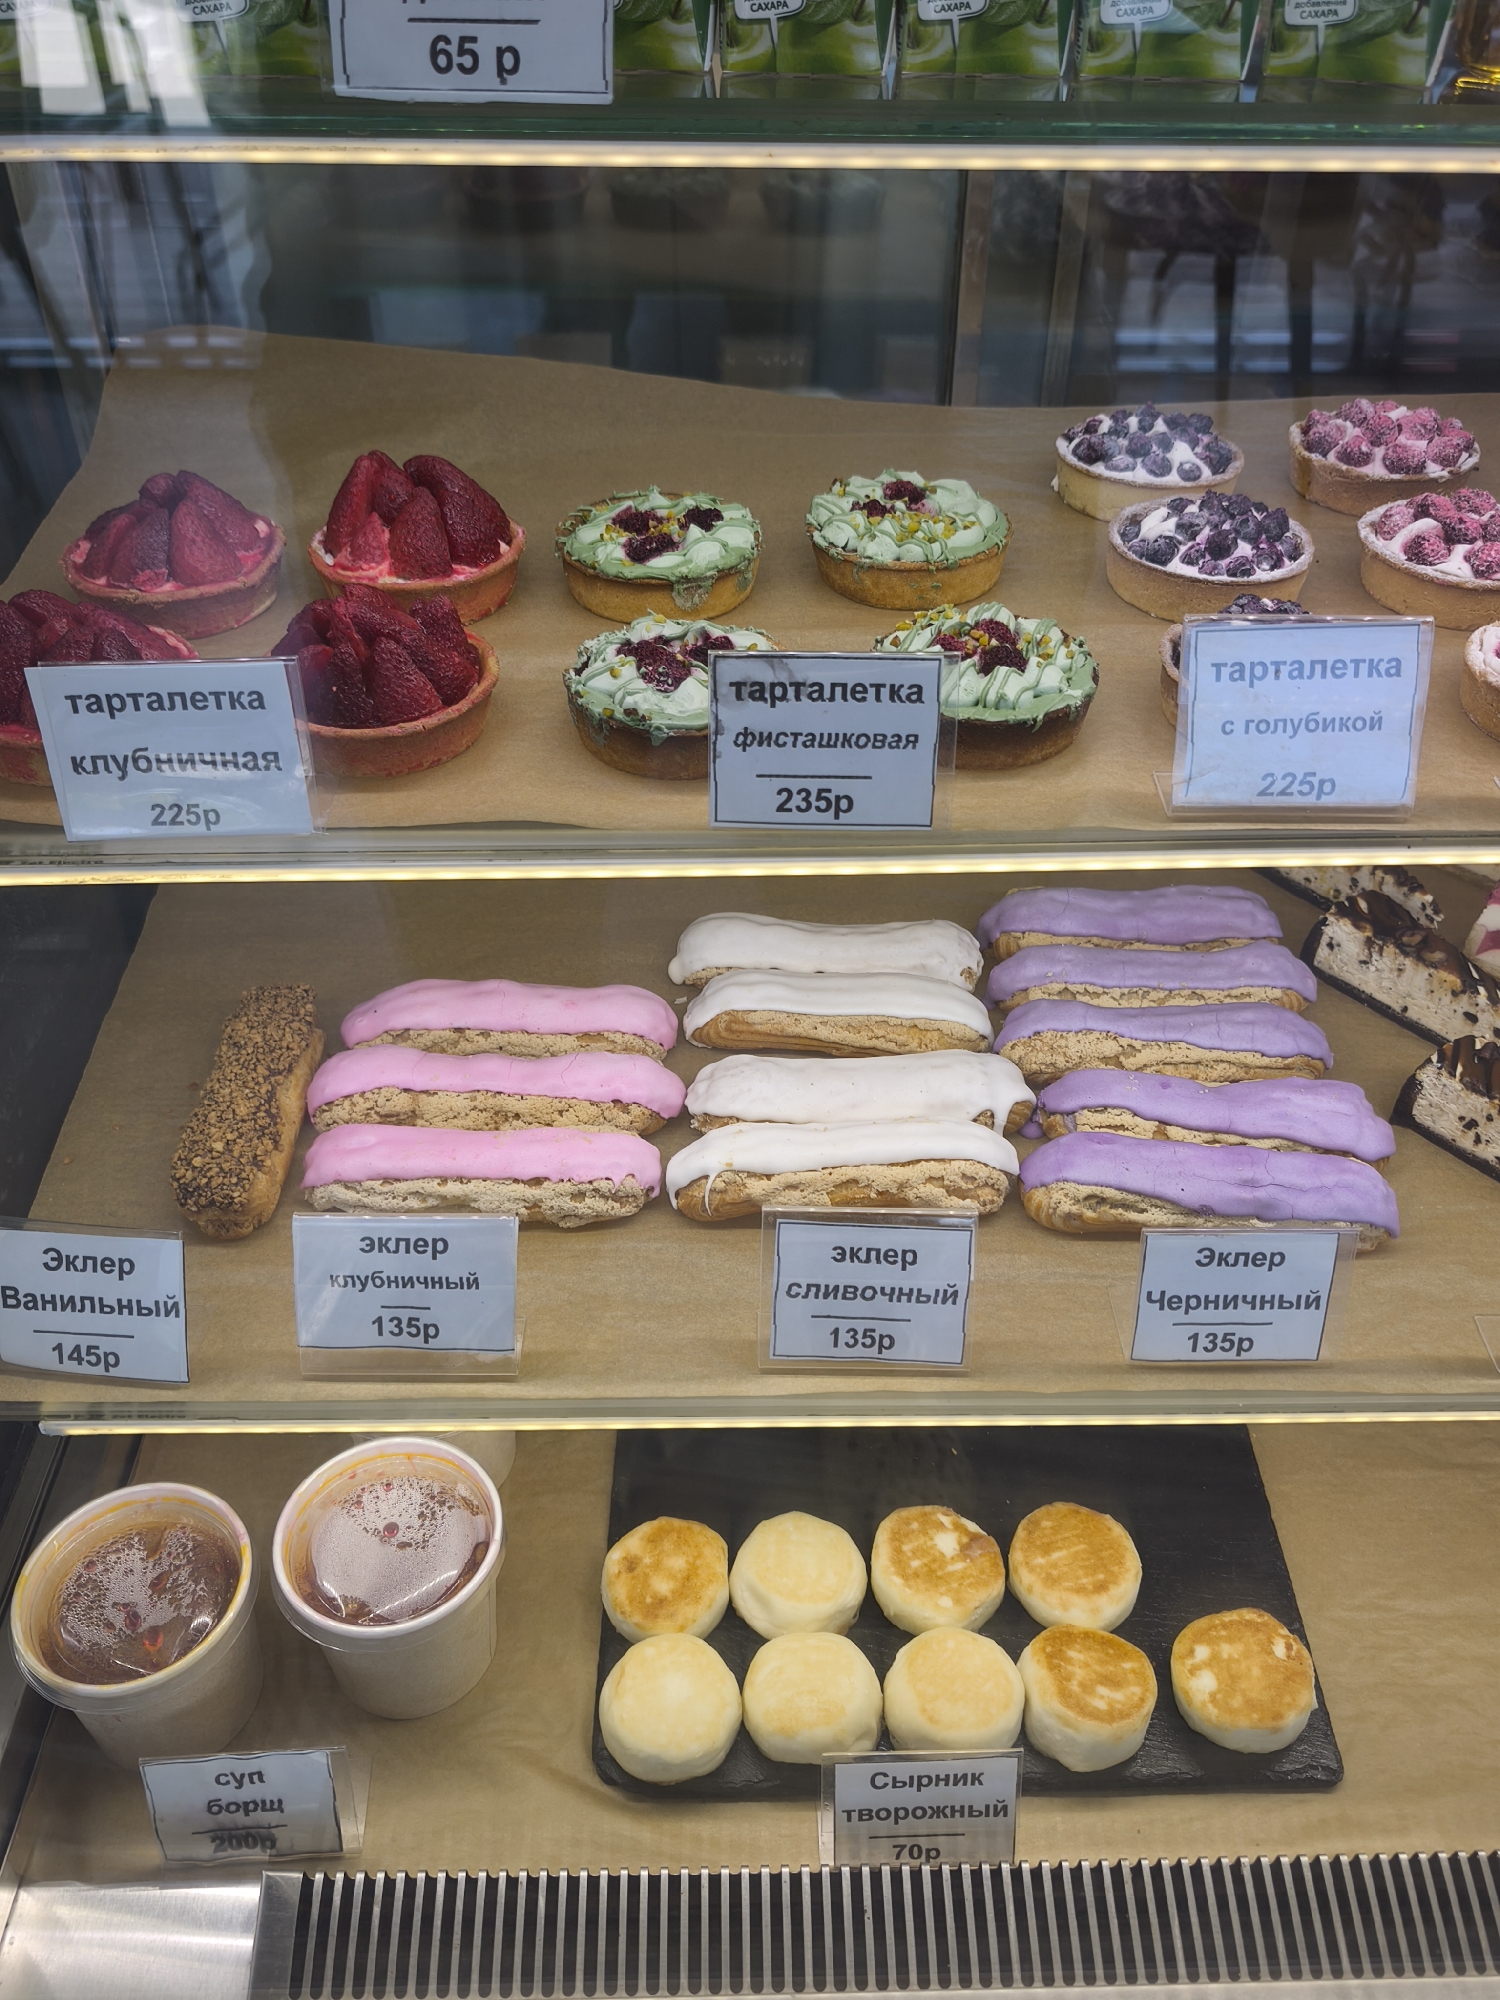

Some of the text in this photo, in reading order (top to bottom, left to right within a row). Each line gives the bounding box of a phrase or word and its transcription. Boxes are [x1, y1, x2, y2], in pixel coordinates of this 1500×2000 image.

[192, 2, 233, 15] САХАРА
[750, 1, 789, 12] САХАРА
[933, 2, 971, 13] САХАРА
[1116, 6, 1154, 17] САХАРА
[1300, 9, 1339, 20] САХАРА
[430, 35, 521, 86] 65 р
[1211, 657, 1402, 688] тарталетка
[65, 690, 266, 719] тарталетка
[729, 681, 925, 708] тарталетка
[1221, 711, 1383, 739] с голубикой
[732, 727, 919, 752] фисташковая
[70, 747, 282, 781] клубничная
[1257, 772, 1336, 801] 225р
[775, 788, 854, 820] 235р
[151, 803, 221, 831] 225р
[359, 1236, 449, 1260] эклер
[831, 1246, 918, 1271] эклер
[1195, 1247, 1286, 1271] Эклер
[42, 1248, 135, 1281] Эклер
[330, 1271, 479, 1292] клубничный
[786, 1282, 959, 1305] сливочный
[0, 1285, 180, 1318] Ванильный
[1146, 1290, 1321, 1315] Черничный
[371, 1316, 440, 1344] 135р
[829, 1327, 895, 1354] 135р
[1187, 1332, 1254, 1357] 135р
[51, 1343, 120, 1373] 145р
[214, 1771, 266, 1790] суп
[870, 1771, 984, 1792] Сырник
[207, 1798, 284, 1817] борщ
[842, 1799, 1009, 1825] творожный
[892, 1844, 941, 1863] 70р
